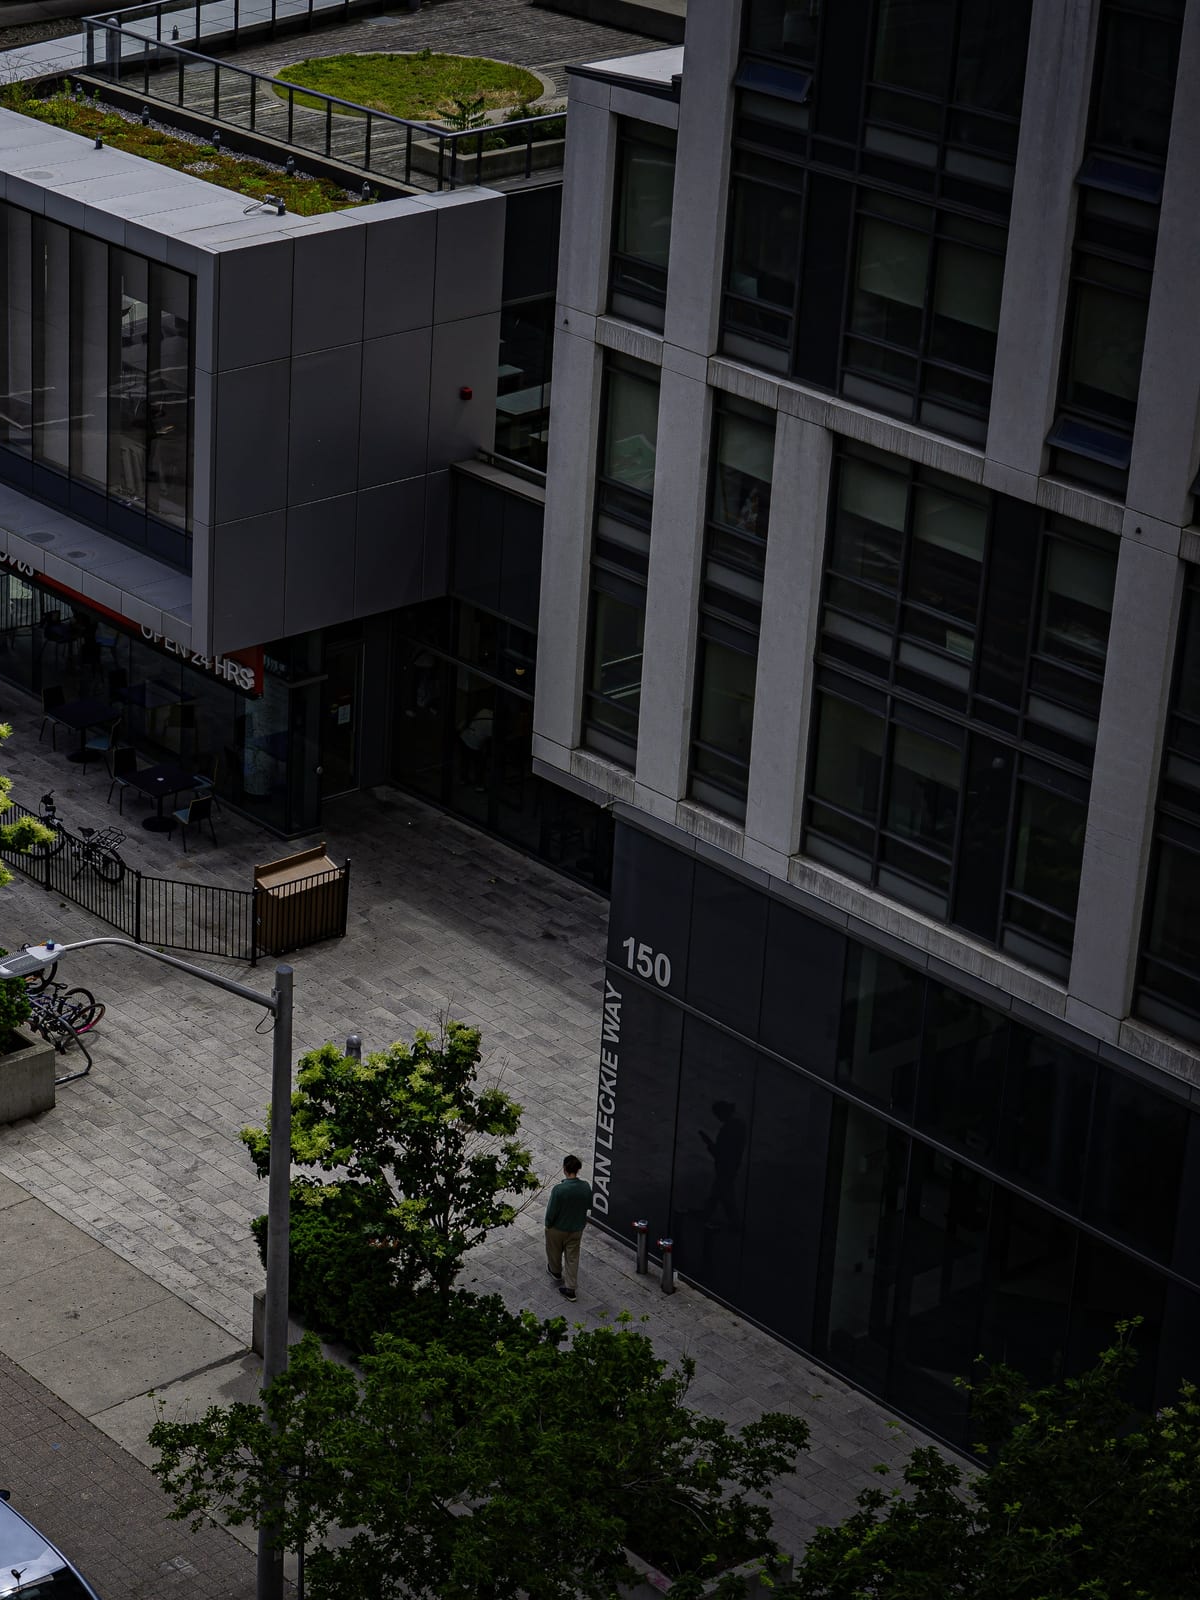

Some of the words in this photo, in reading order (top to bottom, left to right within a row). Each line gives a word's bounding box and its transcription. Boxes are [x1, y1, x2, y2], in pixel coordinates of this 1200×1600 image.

[215, 655, 256, 691] HRS
[623, 936, 671, 988] 150
[602, 979, 623, 1044] WAY
[596, 1047, 619, 1151] LECKIE
[592, 1151, 612, 1216] DAN
